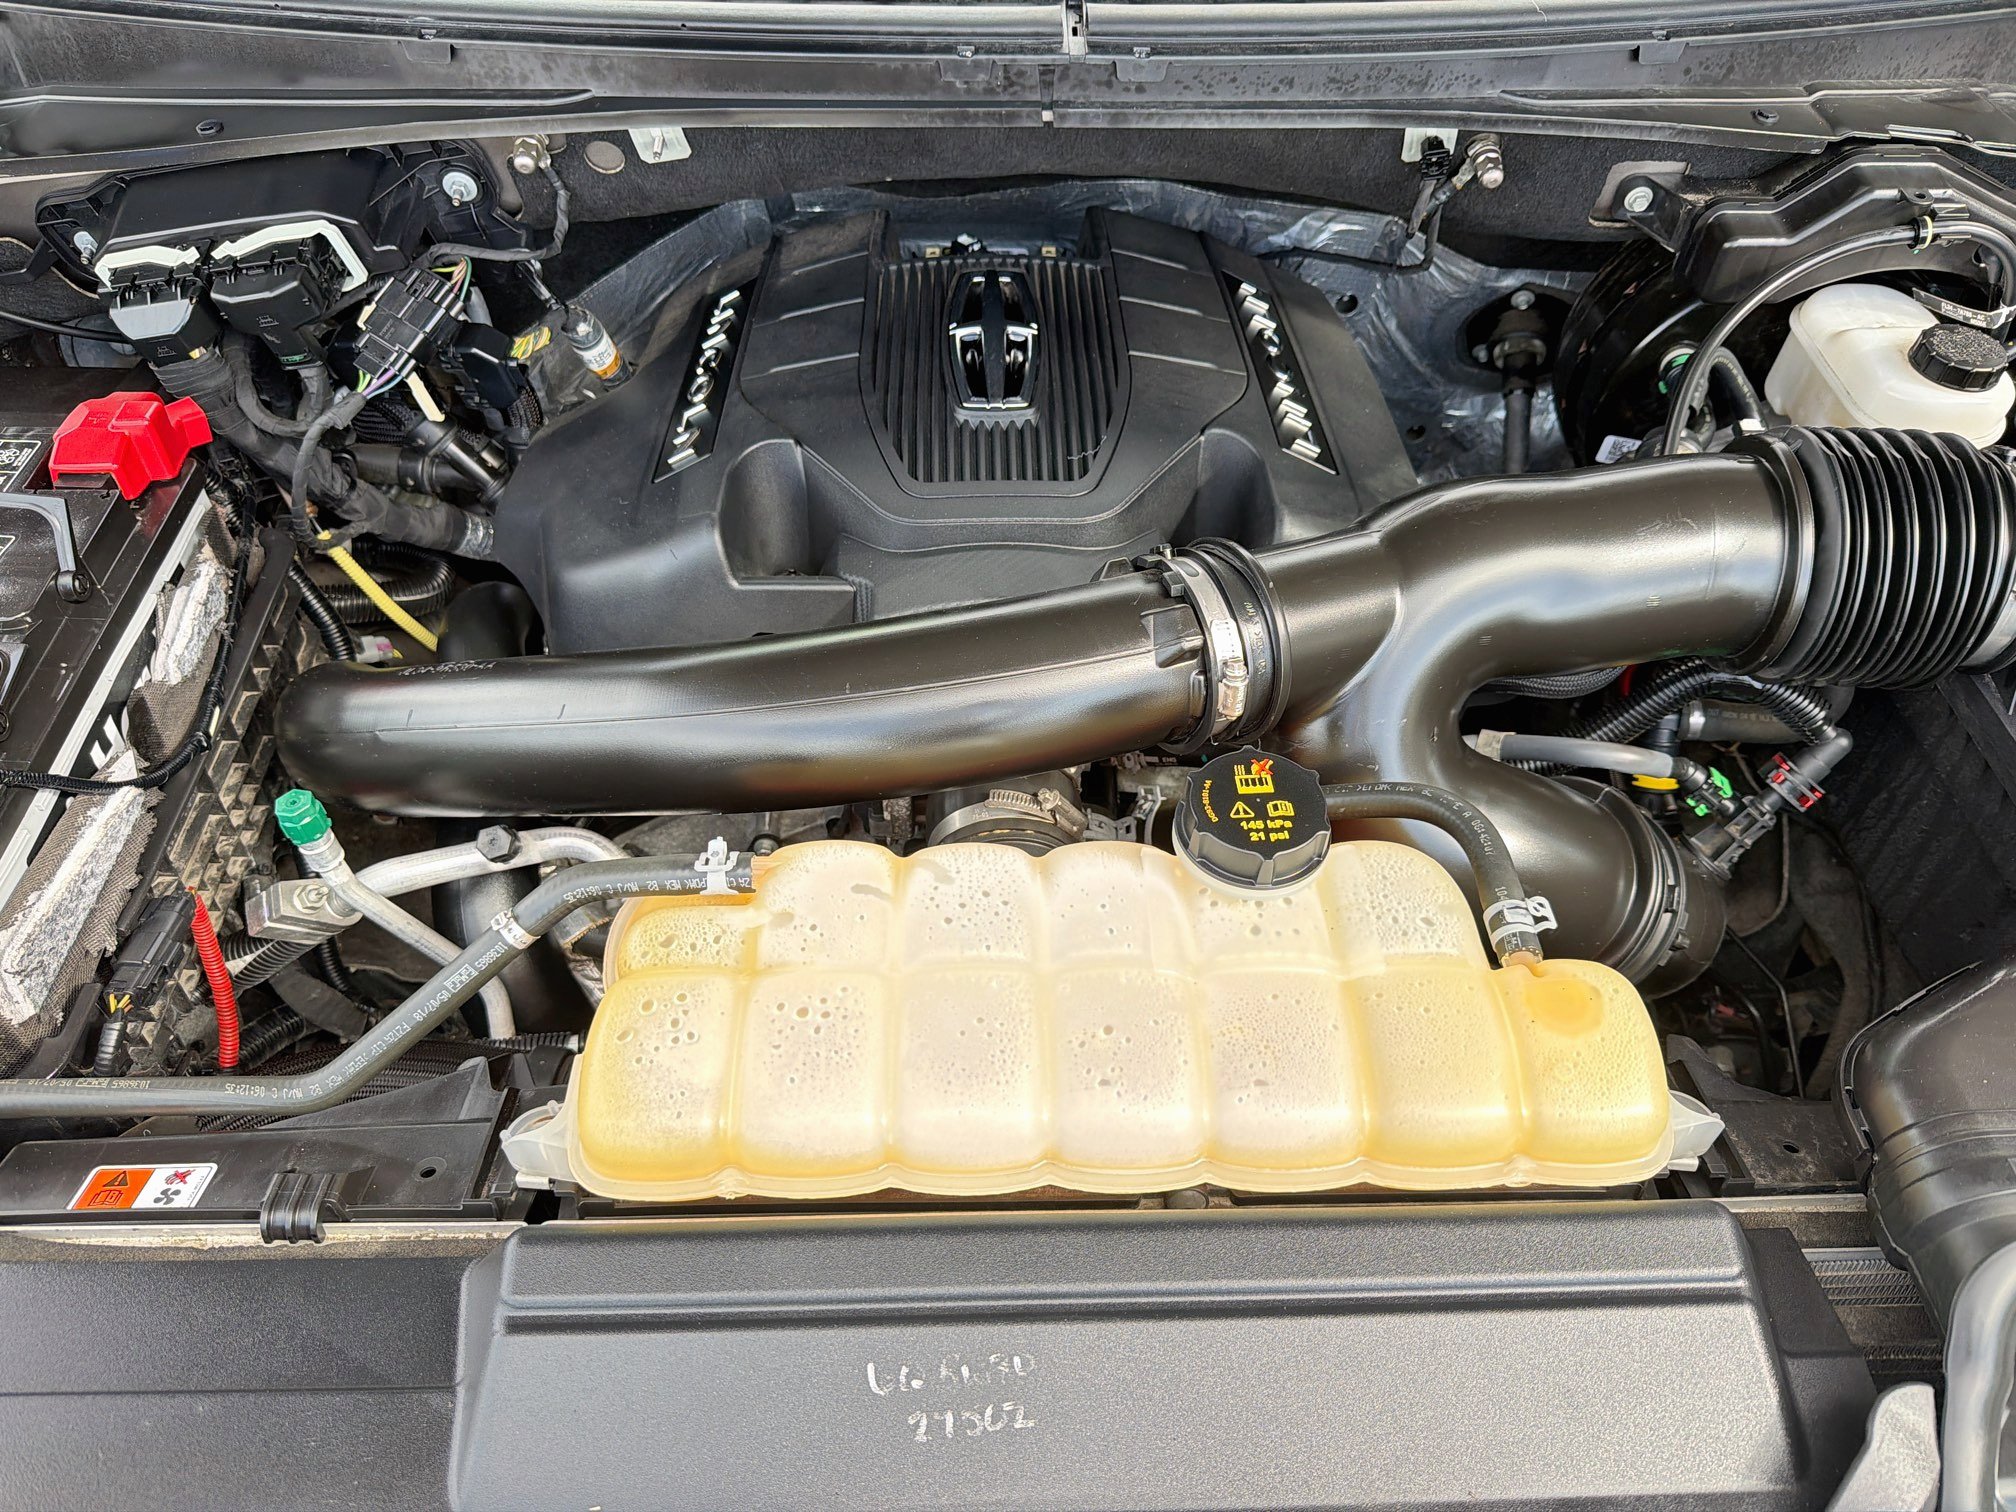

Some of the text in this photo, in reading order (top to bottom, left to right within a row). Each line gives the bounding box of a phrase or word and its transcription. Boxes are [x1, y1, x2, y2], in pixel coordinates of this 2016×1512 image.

[1240, 819, 1293, 830] 145 kPa
[1249, 831, 1290, 842] 21 psi
[606, 883, 613, 893] C
[647, 880, 658, 890] B2
[665, 879, 682, 891] MEX
[476, 942, 508, 970] 1036865
[413, 989, 450, 1021] 05/07/18
[111, 1079, 150, 1089] 1036865
[224, 1083, 265, 1097] 06:12:35
[271, 1087, 278, 1098] C
